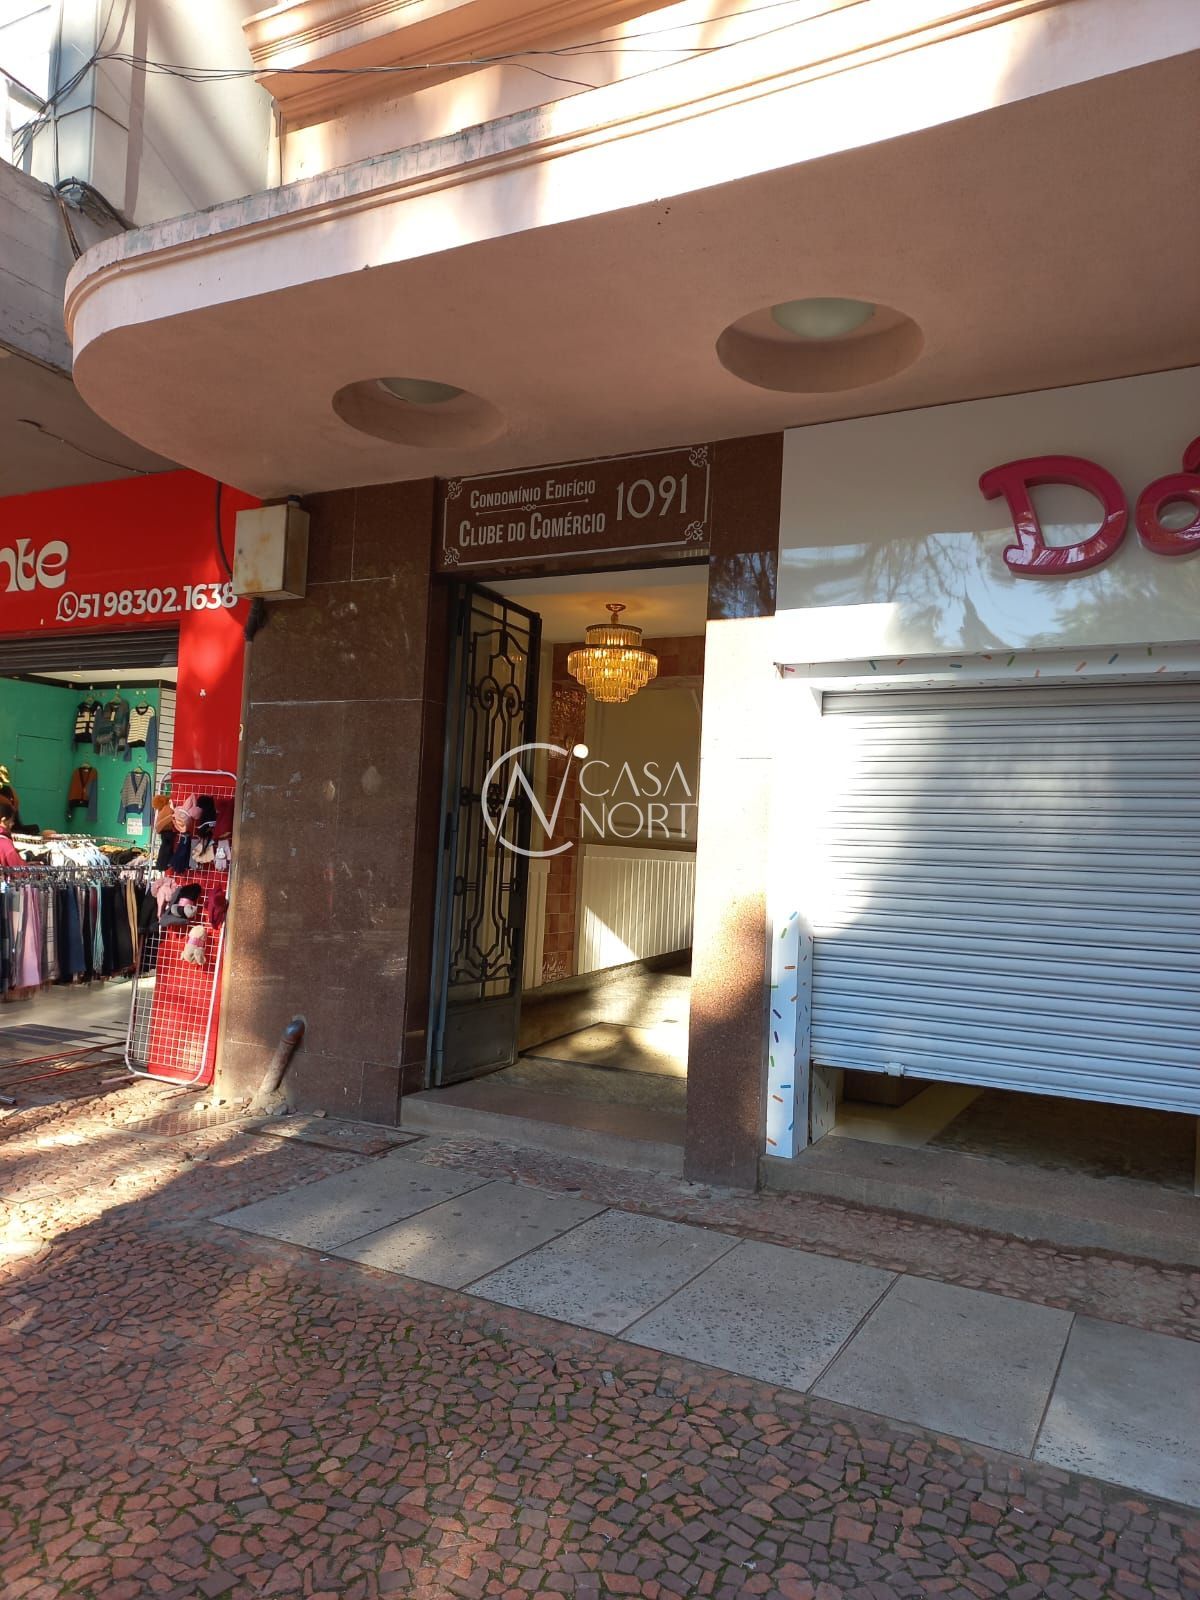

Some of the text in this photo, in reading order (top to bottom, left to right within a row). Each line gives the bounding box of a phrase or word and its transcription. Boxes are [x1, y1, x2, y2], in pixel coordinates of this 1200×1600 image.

[470, 478, 596, 509] CONDOMÍNIO EDIFÍCIO
[616, 473, 688, 521] 1091
[459, 511, 606, 547] CLUBE DO COMÉRCIO
[77, 582, 238, 619] 51 98302.1638
